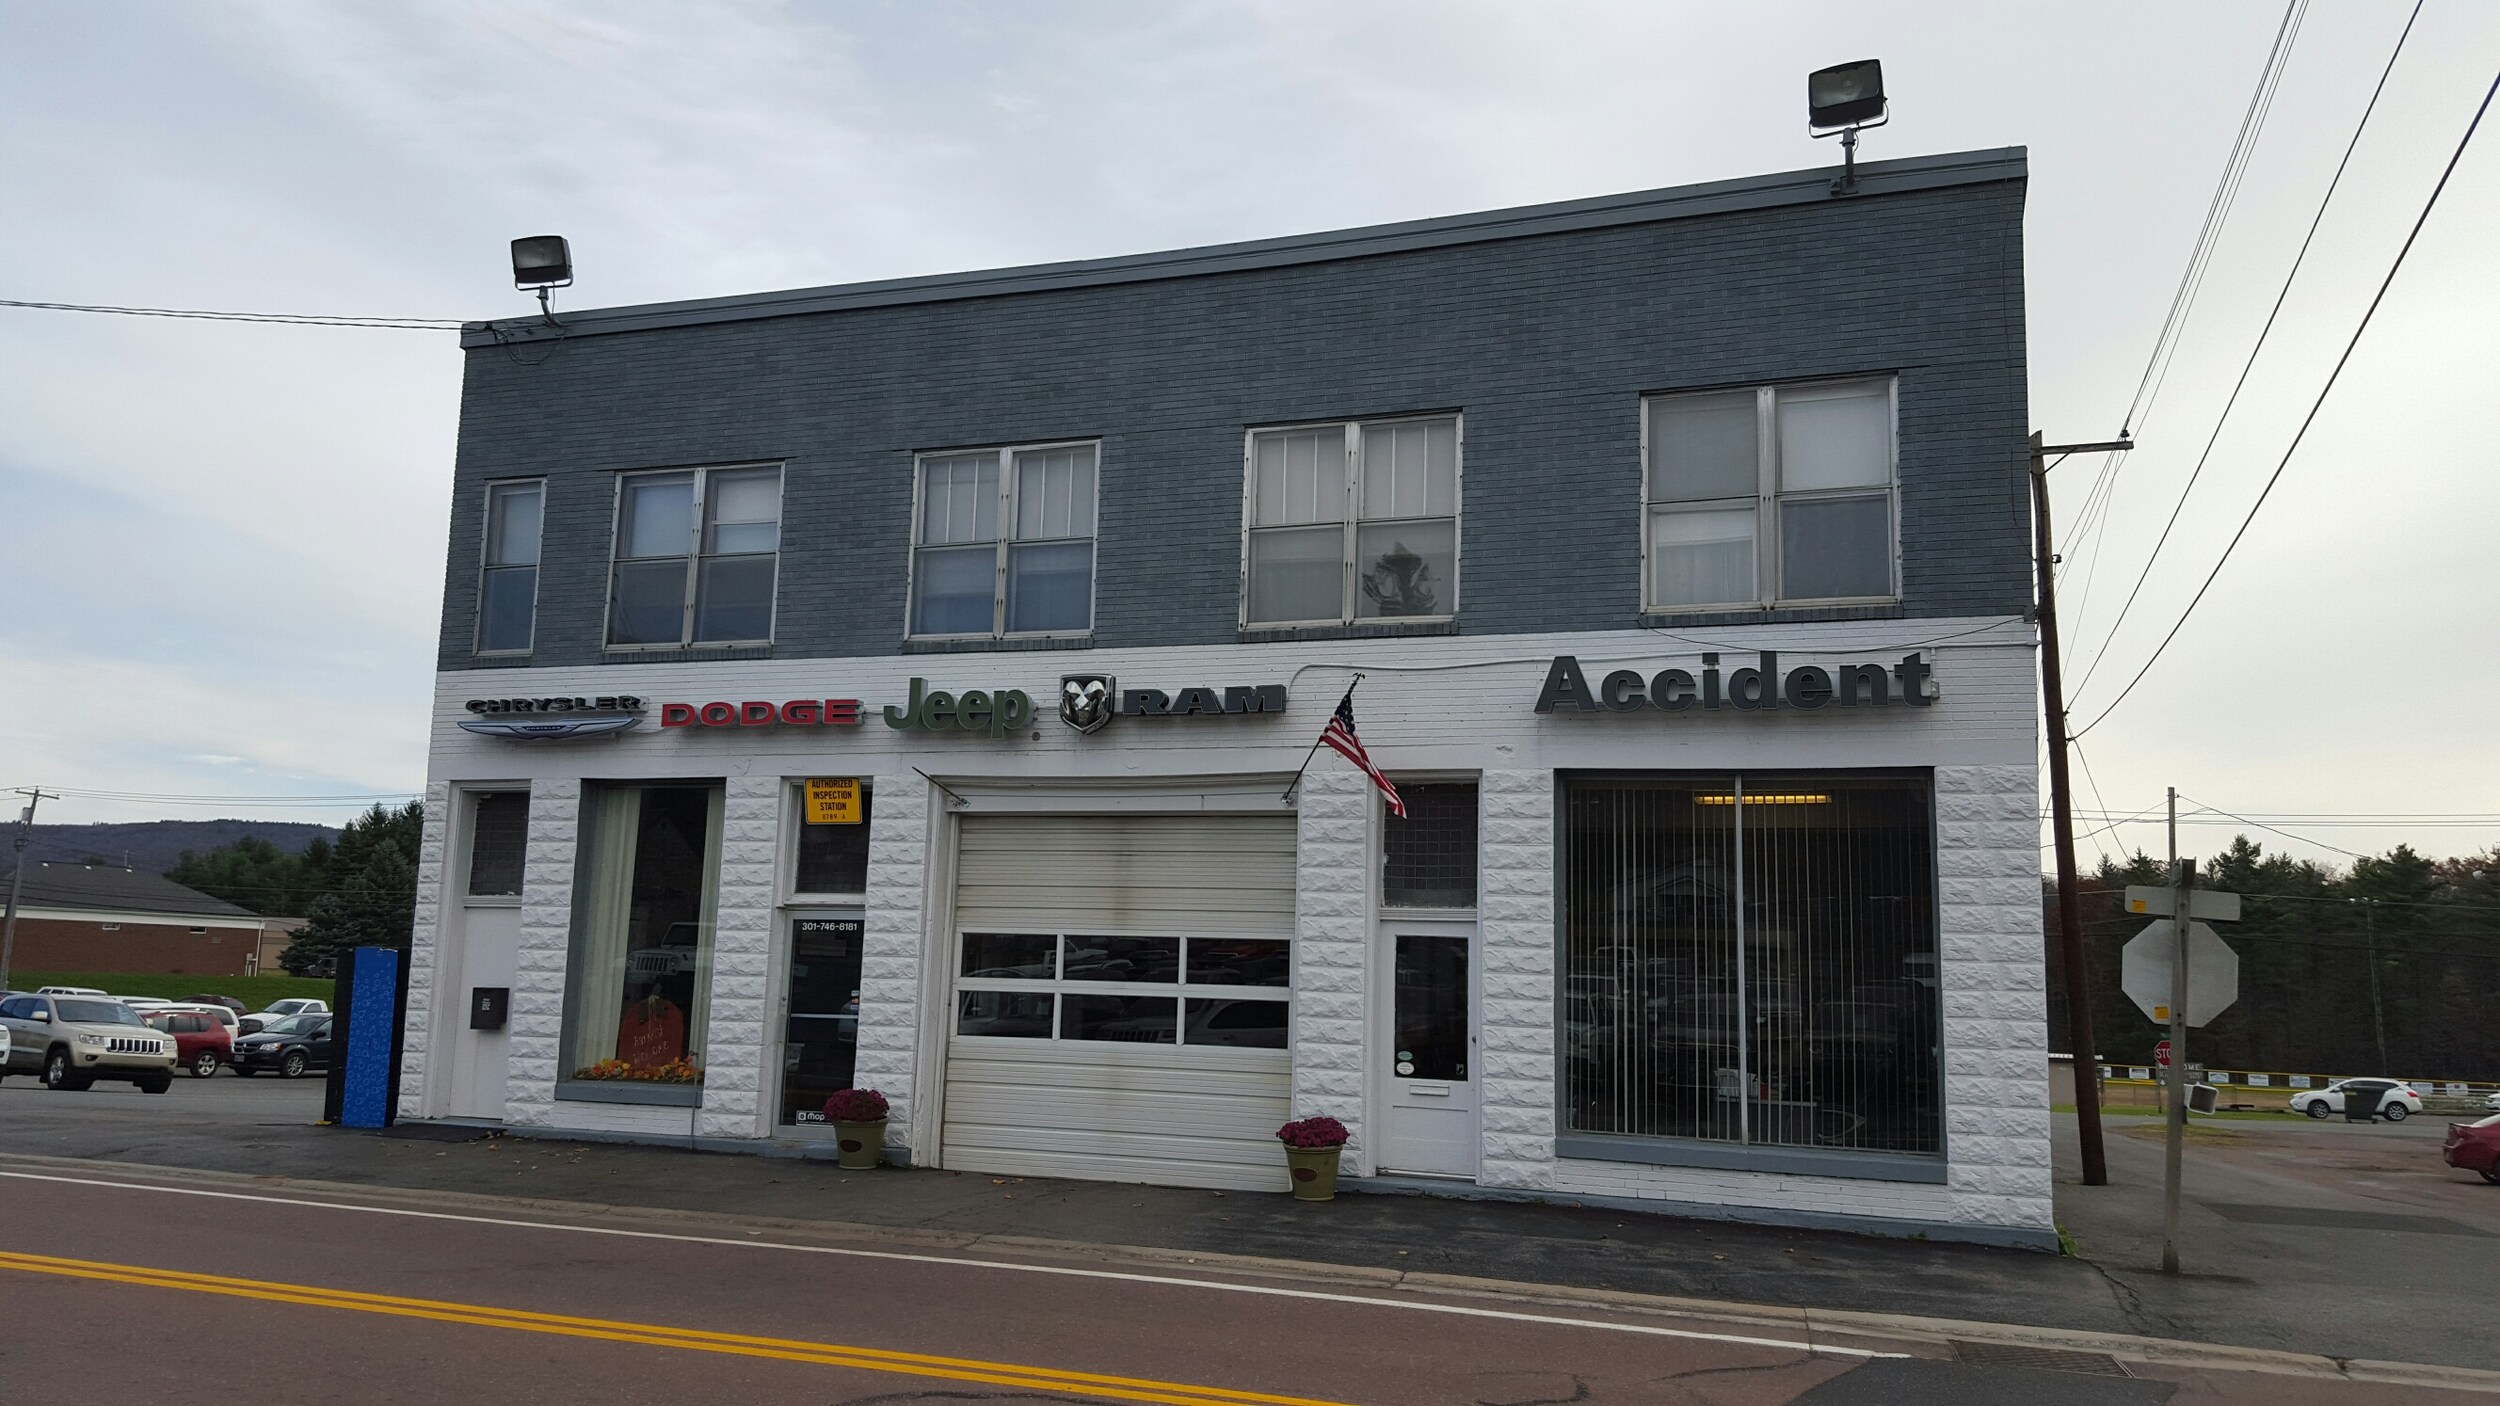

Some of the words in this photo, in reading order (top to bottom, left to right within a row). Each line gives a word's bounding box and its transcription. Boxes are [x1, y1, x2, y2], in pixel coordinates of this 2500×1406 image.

[1533, 650, 1931, 714] Accident
[465, 694, 642, 713] CHRYSLER
[1122, 684, 1287, 716] RAM
[660, 698, 865, 728] DODGE
[883, 677, 1034, 740] Jeep
[811, 779, 853, 788] AUTHORIZED
[813, 790, 853, 799] INSPECTION
[820, 802, 847, 811] STATION
[802, 922, 857, 931] 301-746-8181
[2156, 1048, 2171, 1059] STO
